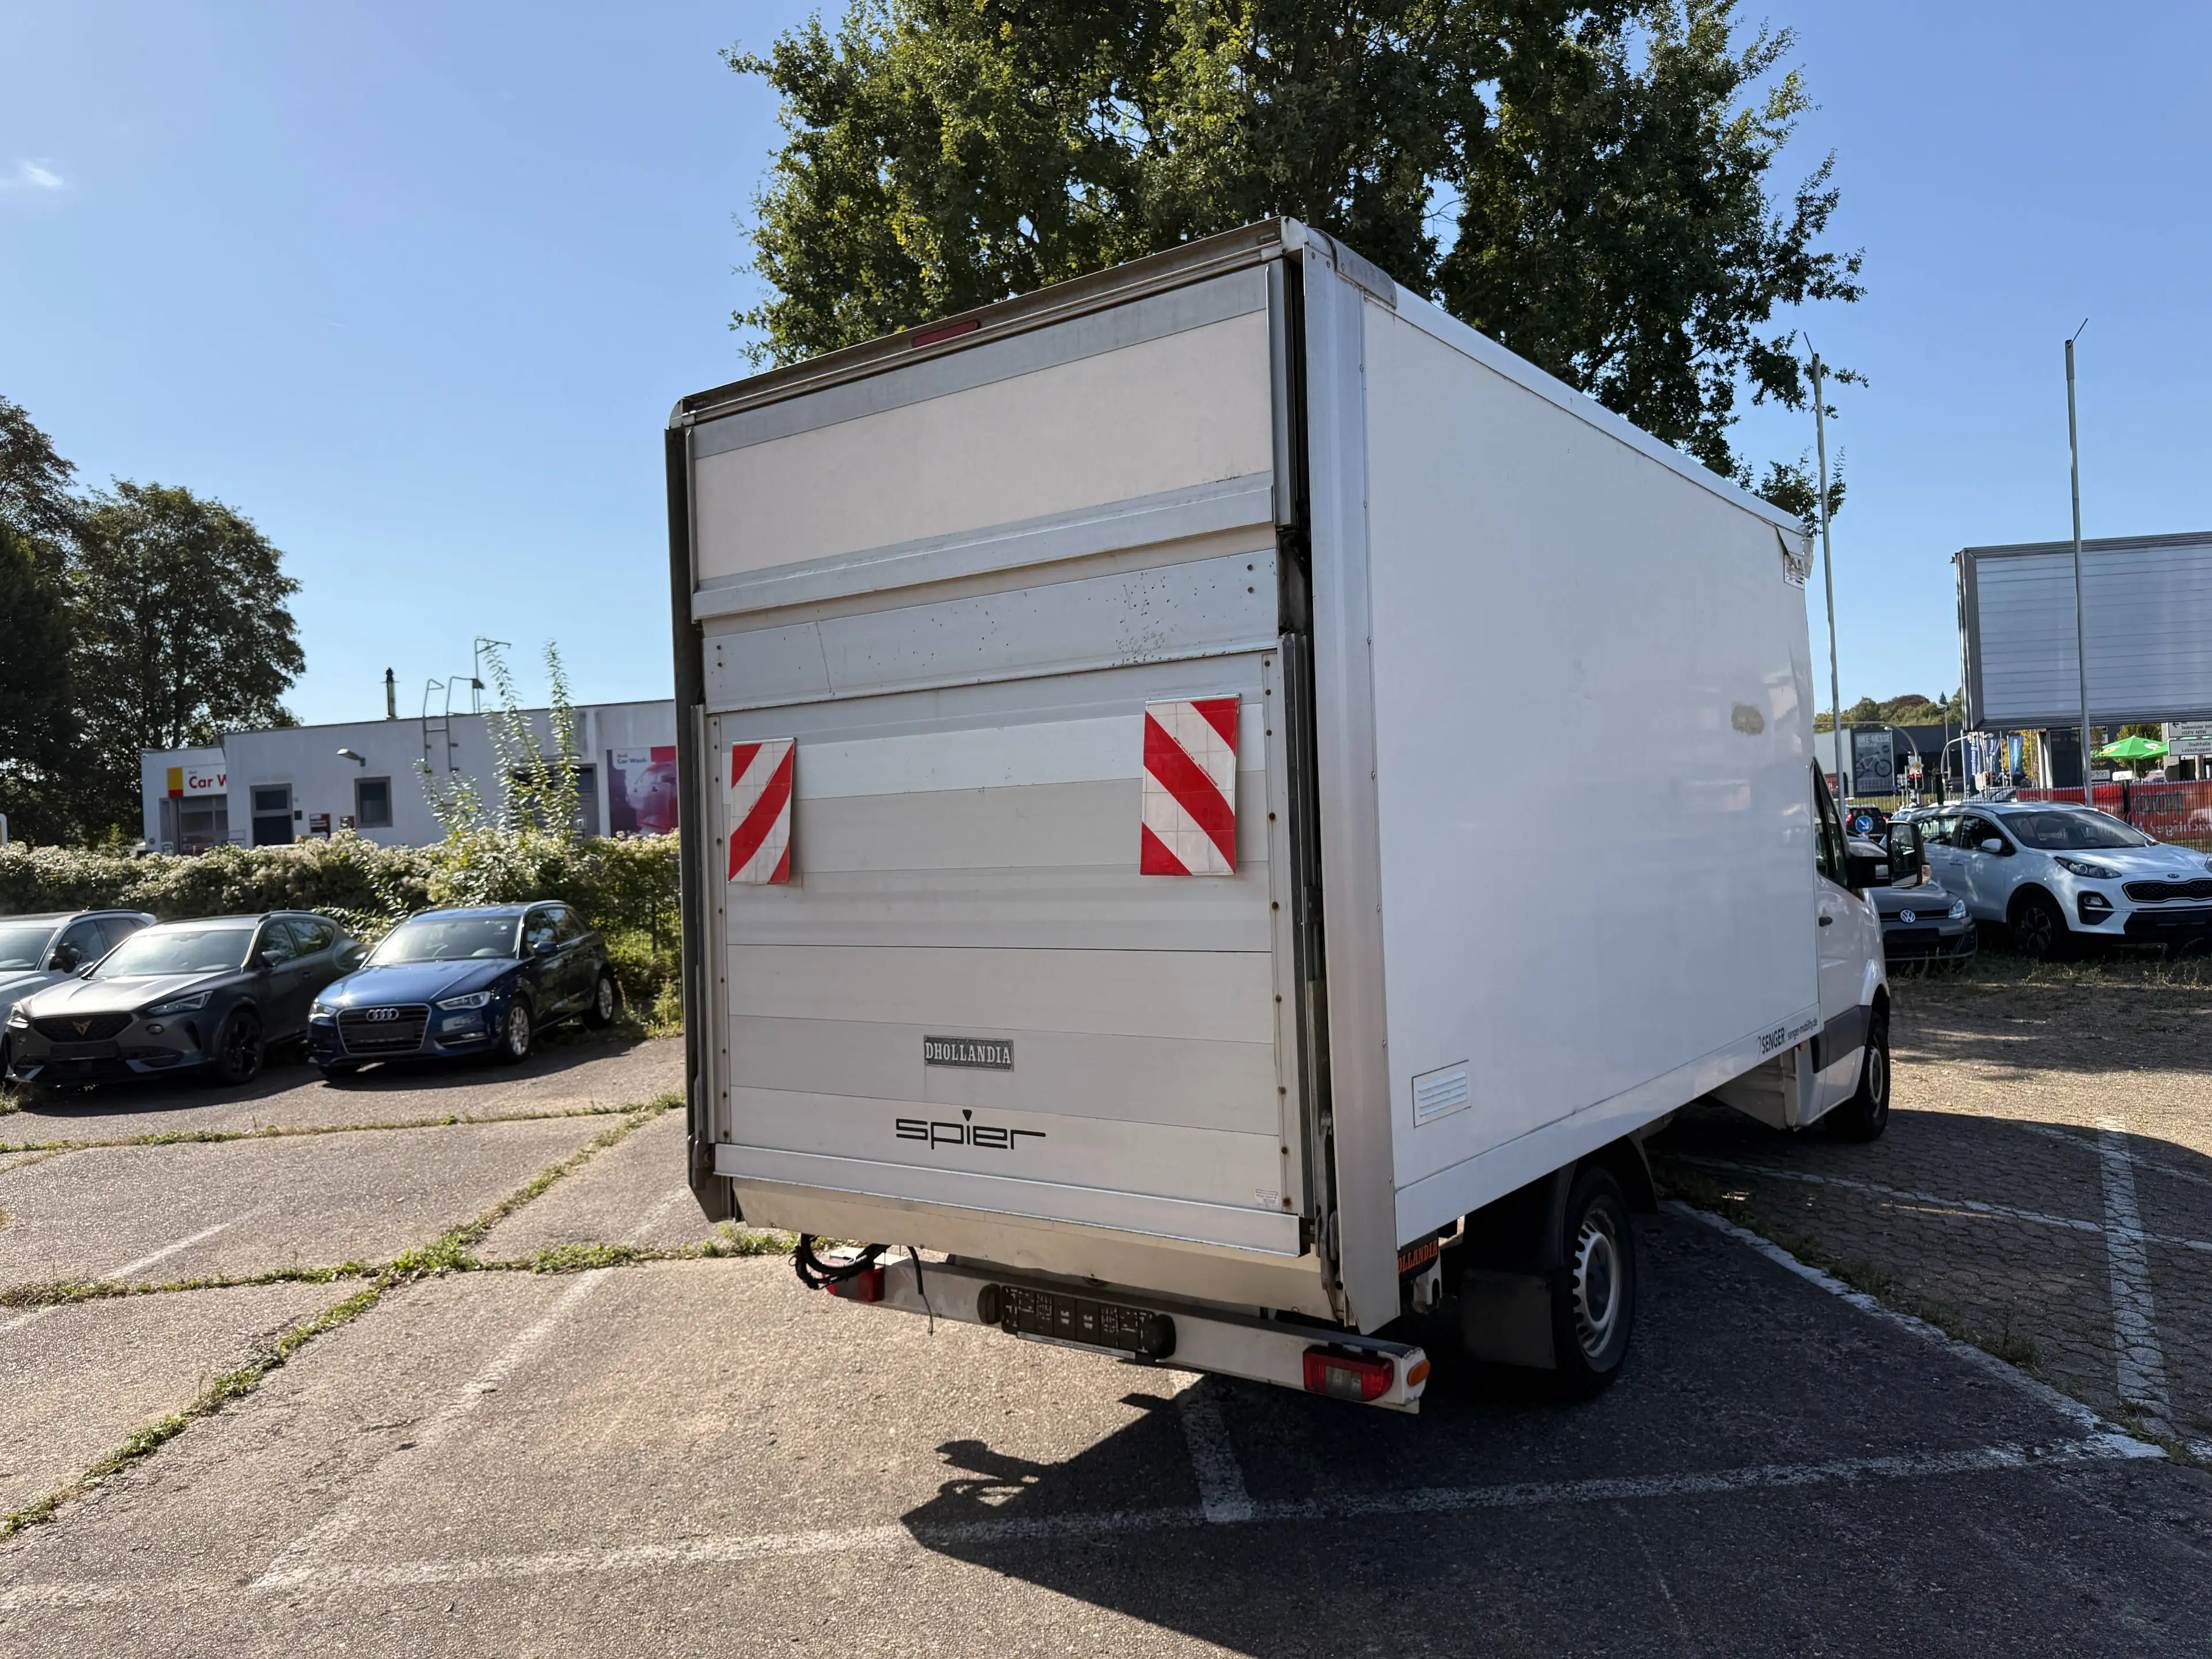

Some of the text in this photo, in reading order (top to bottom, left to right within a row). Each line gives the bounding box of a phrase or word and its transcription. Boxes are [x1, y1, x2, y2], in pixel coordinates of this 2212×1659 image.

[188, 775, 213, 789] Car
[925, 1042, 1012, 1064] DHOLLANDIA
[1762, 1027, 1785, 1055] SENGER
[895, 1109, 1047, 1150] spier
[1397, 1240, 1438, 1275] OLLANDIA
